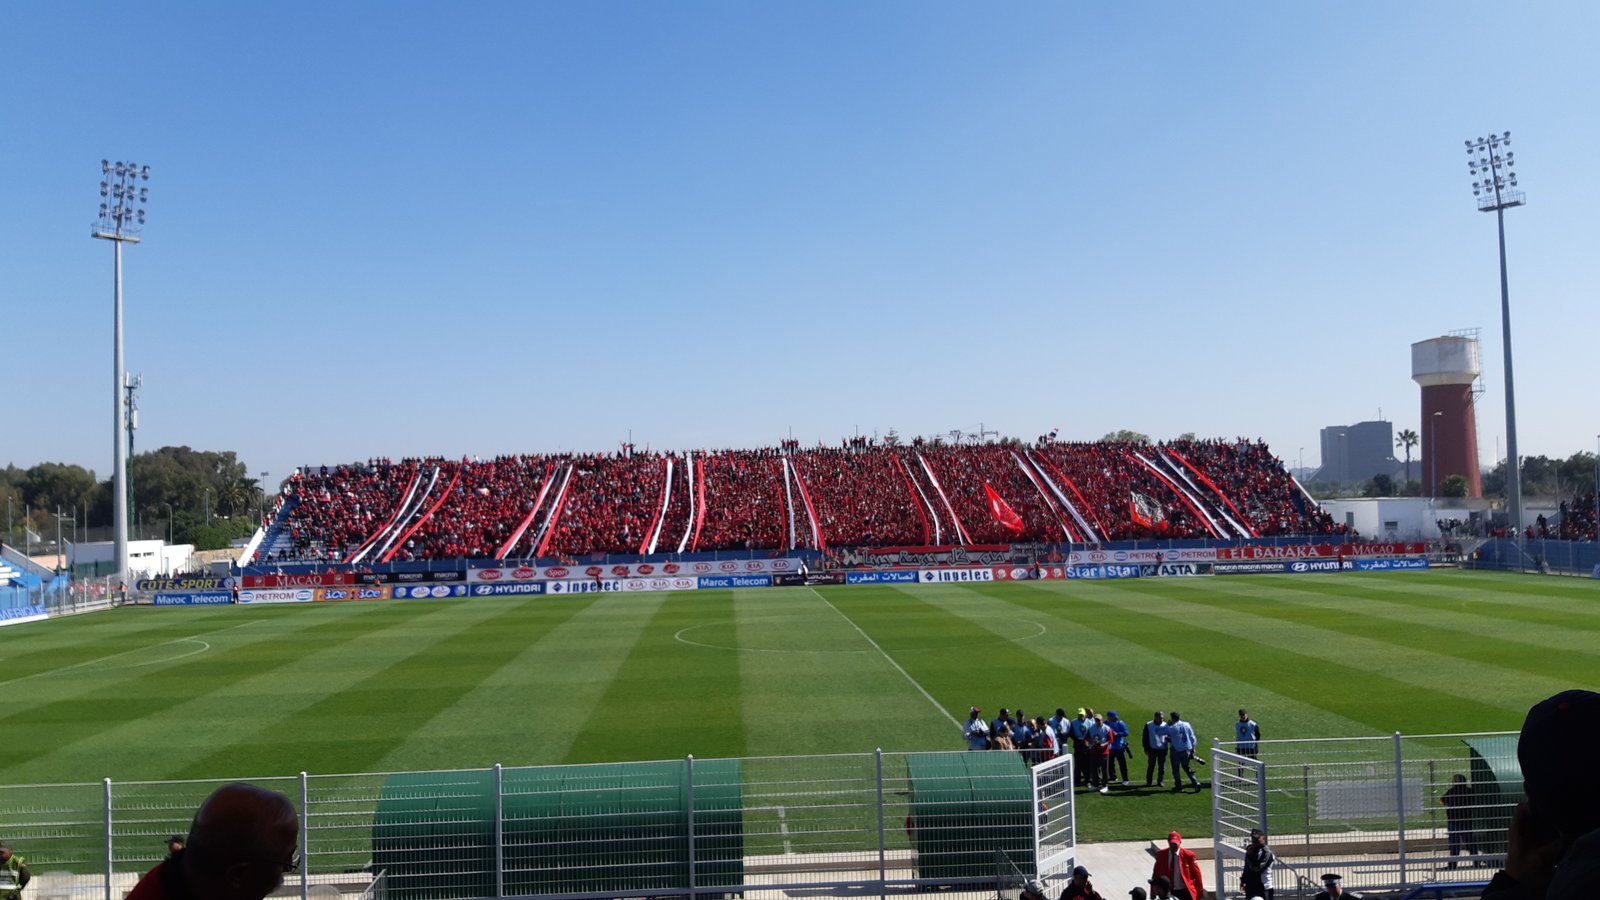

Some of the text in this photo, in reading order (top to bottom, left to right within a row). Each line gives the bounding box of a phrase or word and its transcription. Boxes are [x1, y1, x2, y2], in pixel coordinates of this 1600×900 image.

[1230, 546, 1320, 558] EL BARAKA
[1352, 545, 1394, 555] MACAO
[1108, 563, 1138, 576] Star
[1161, 564, 1194, 576] ASTA
[1310, 561, 1353, 570] HYUNAI
[1361, 559, 1426, 570] اتصالات المغرب
[848, 571, 916, 582] اتصالات المغرب
[938, 569, 990, 581] ingelec
[1066, 565, 1097, 577] Star
[180, 579, 221, 589] SPORT
[276, 575, 322, 586] MACAO
[567, 580, 619, 592] ingeec
[700, 577, 769, 587] Maroc Telecom
[496, 584, 541, 593] HYUNDAI
[156, 595, 186, 605] Maroc
[190, 593, 229, 604] Telecom
[255, 592, 295, 601] PETROM
